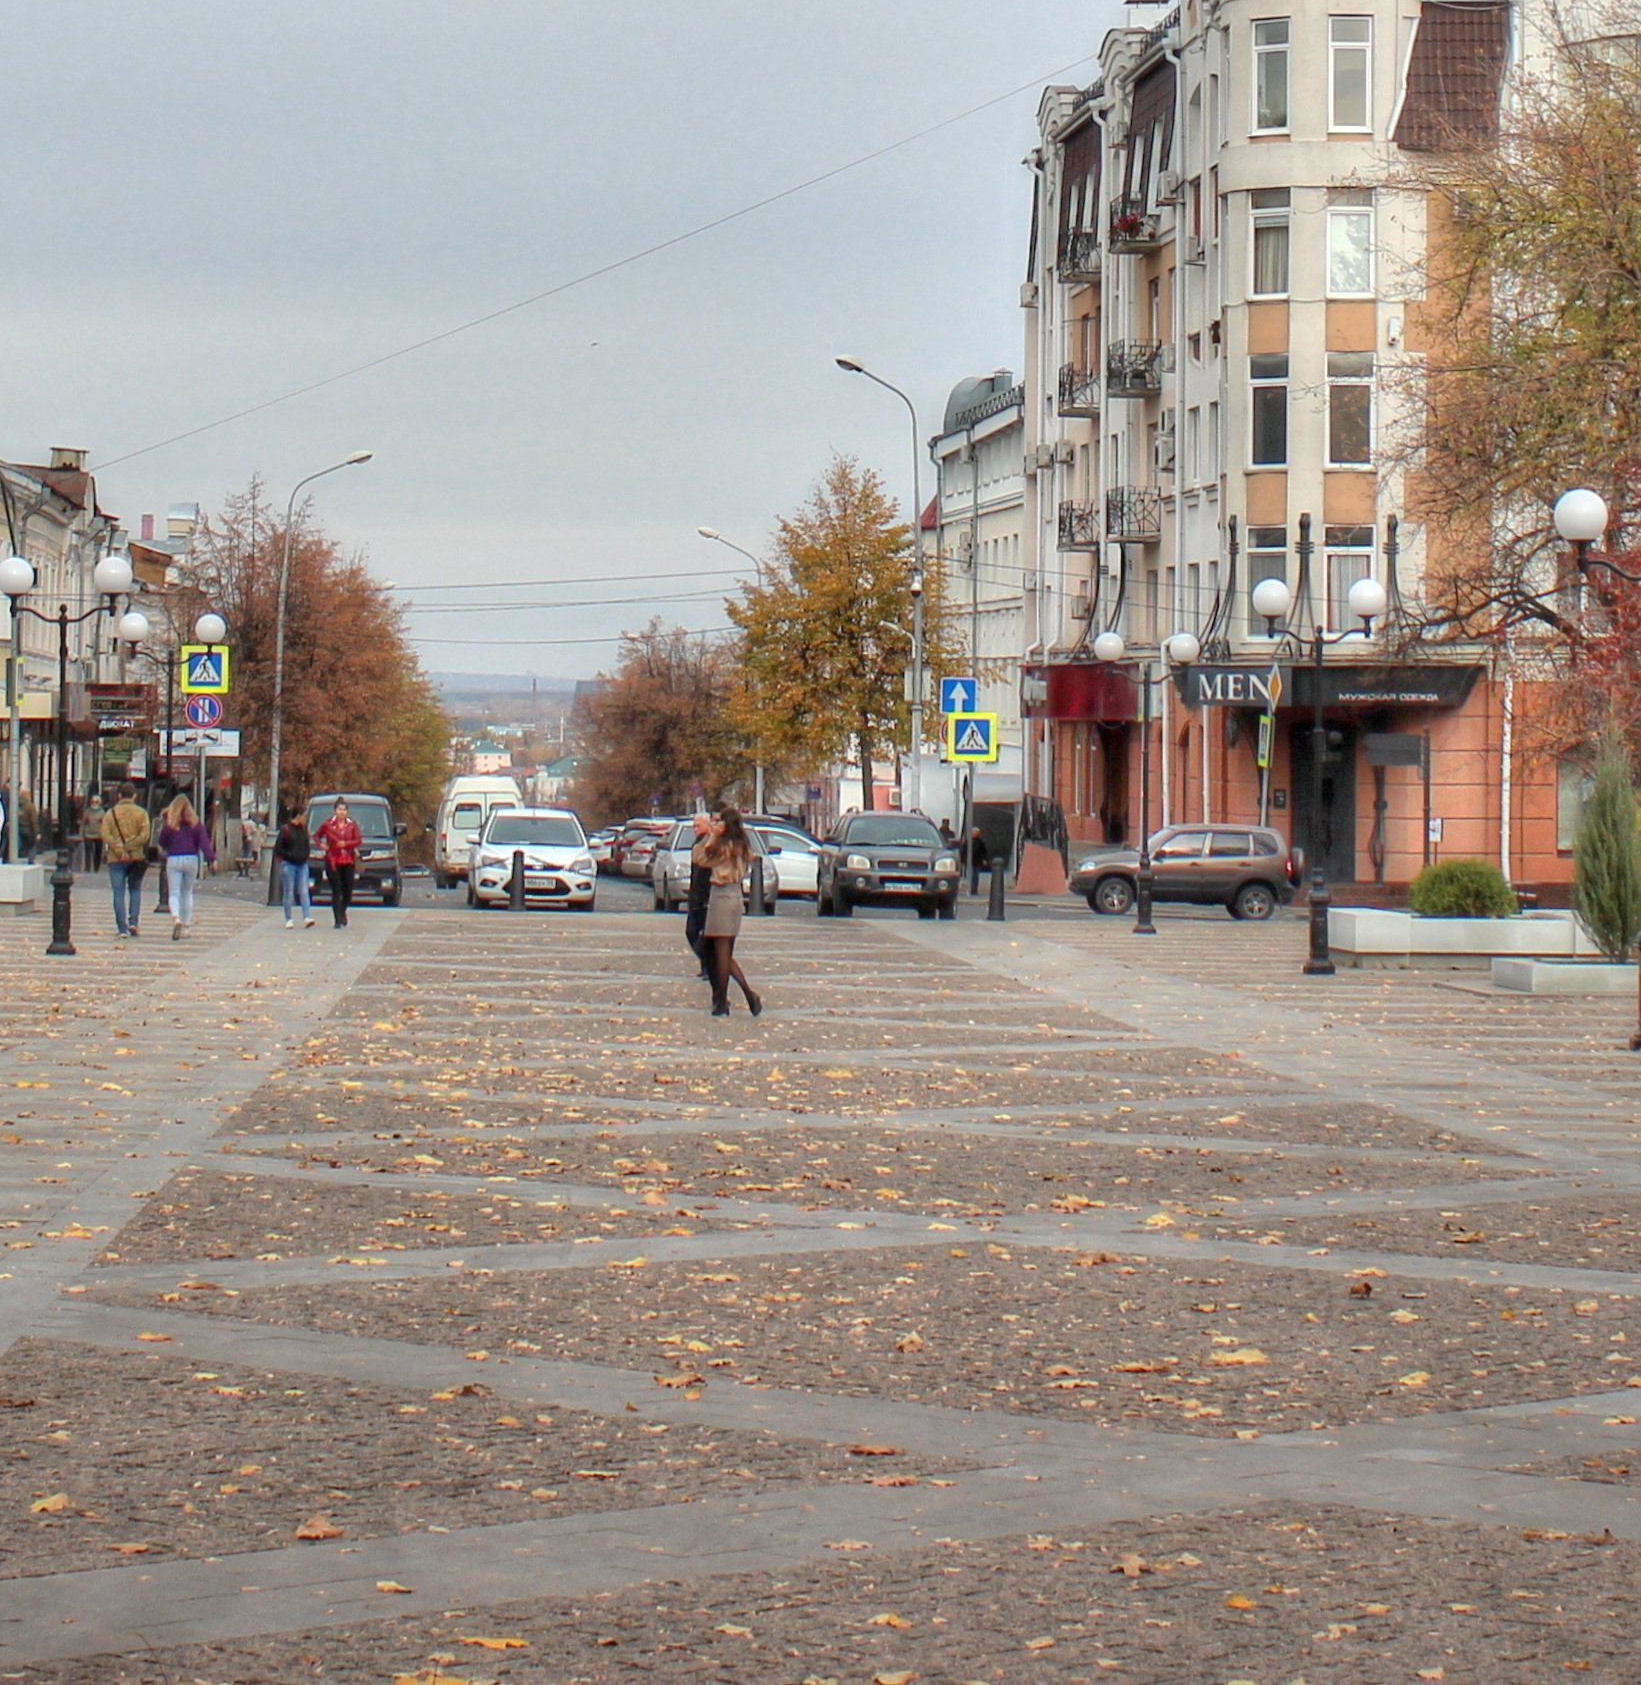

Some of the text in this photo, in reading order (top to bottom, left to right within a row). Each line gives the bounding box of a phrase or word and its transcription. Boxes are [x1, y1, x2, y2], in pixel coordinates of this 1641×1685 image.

[1198, 674, 1271, 701] MEN
[1338, 693, 1440, 703] МУЖСКАЯ ОДЕЖДА
